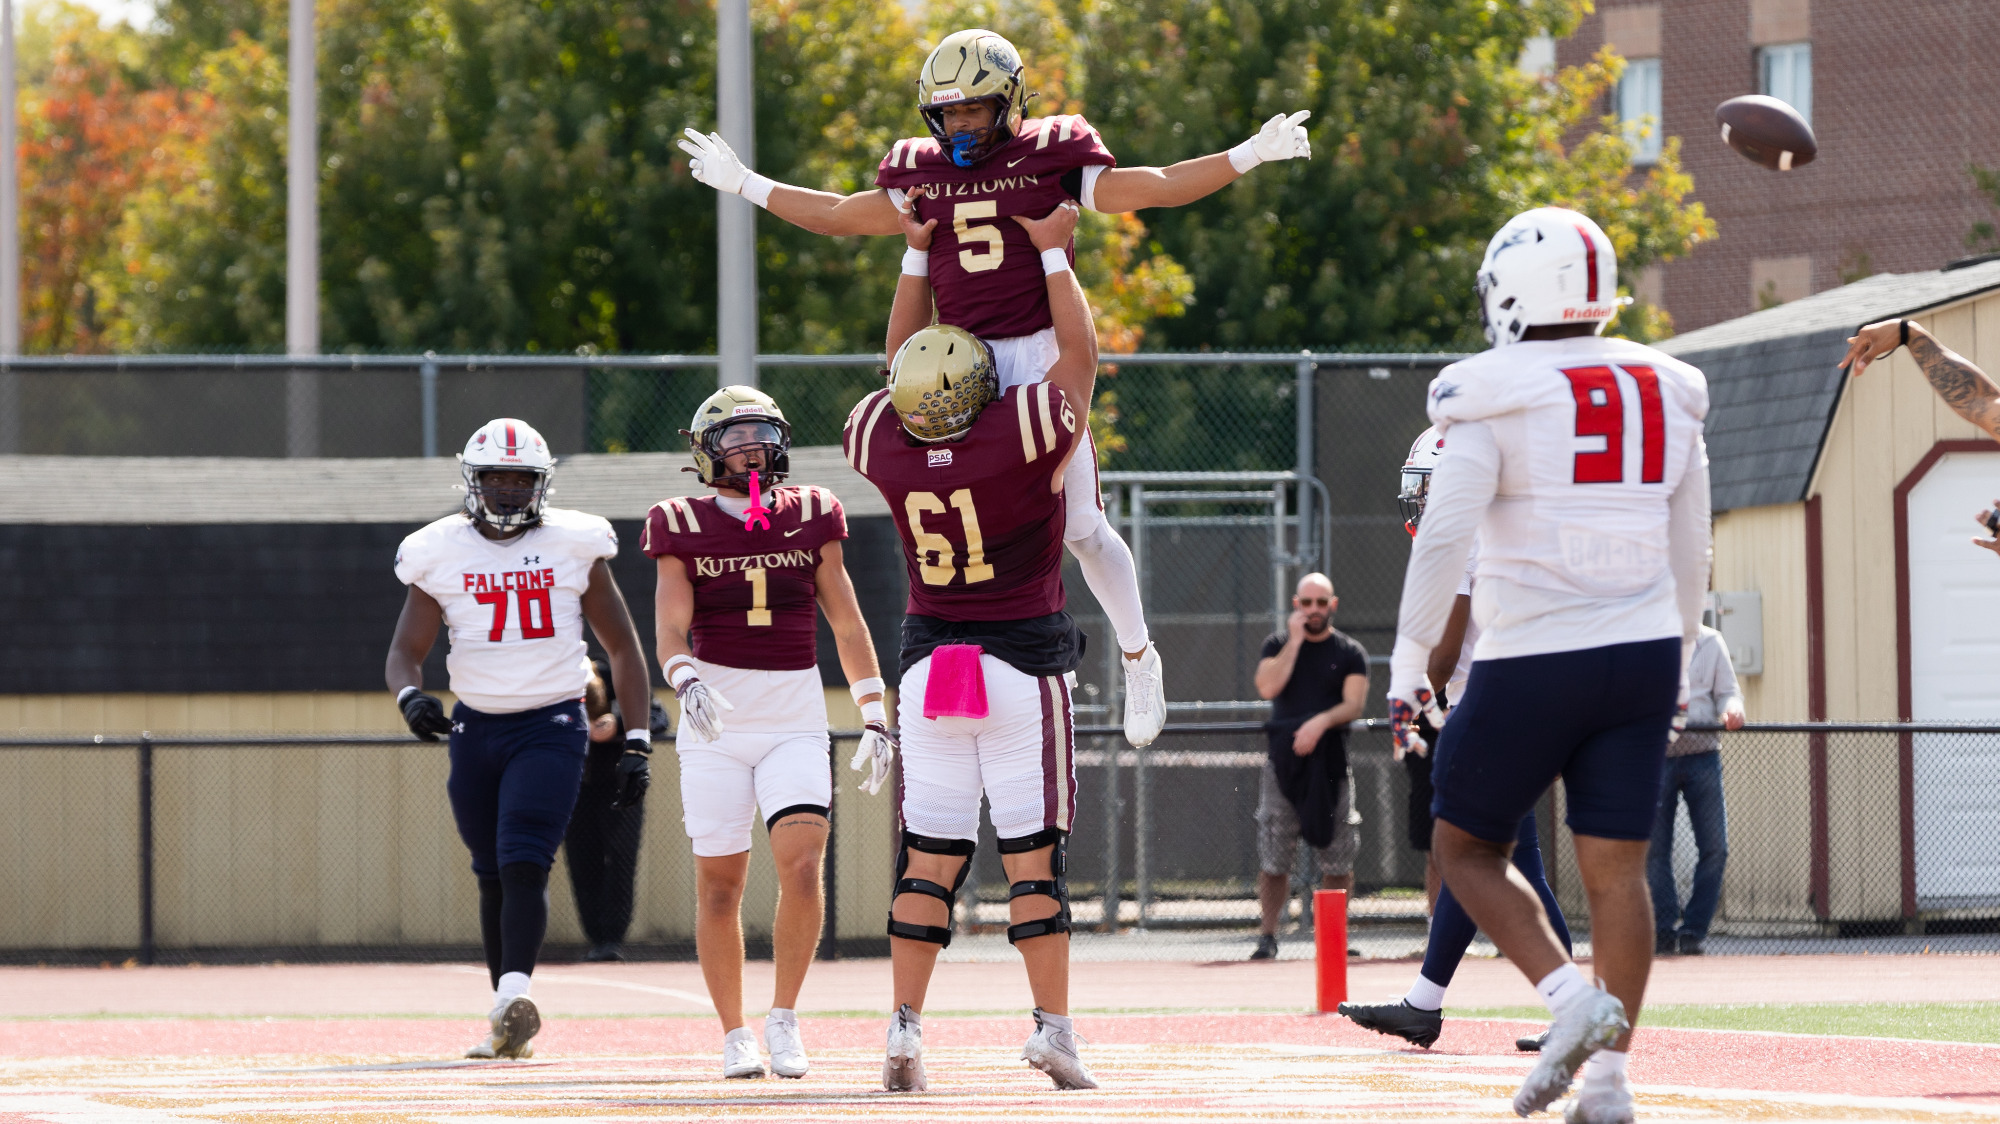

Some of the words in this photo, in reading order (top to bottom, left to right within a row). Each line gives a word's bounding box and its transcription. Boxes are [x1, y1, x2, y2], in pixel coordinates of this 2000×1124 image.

[933, 92, 960, 102] Riddell
[953, 200, 1004, 273] 5
[1558, 364, 1666, 484] 91
[929, 453, 951, 462] PSAC
[694, 549, 814, 577] KUTZTOWN
[904, 488, 995, 586] 61
[462, 568, 555, 592] FALCONS
[745, 567, 772, 626] 1
[473, 588, 555, 642] 70
